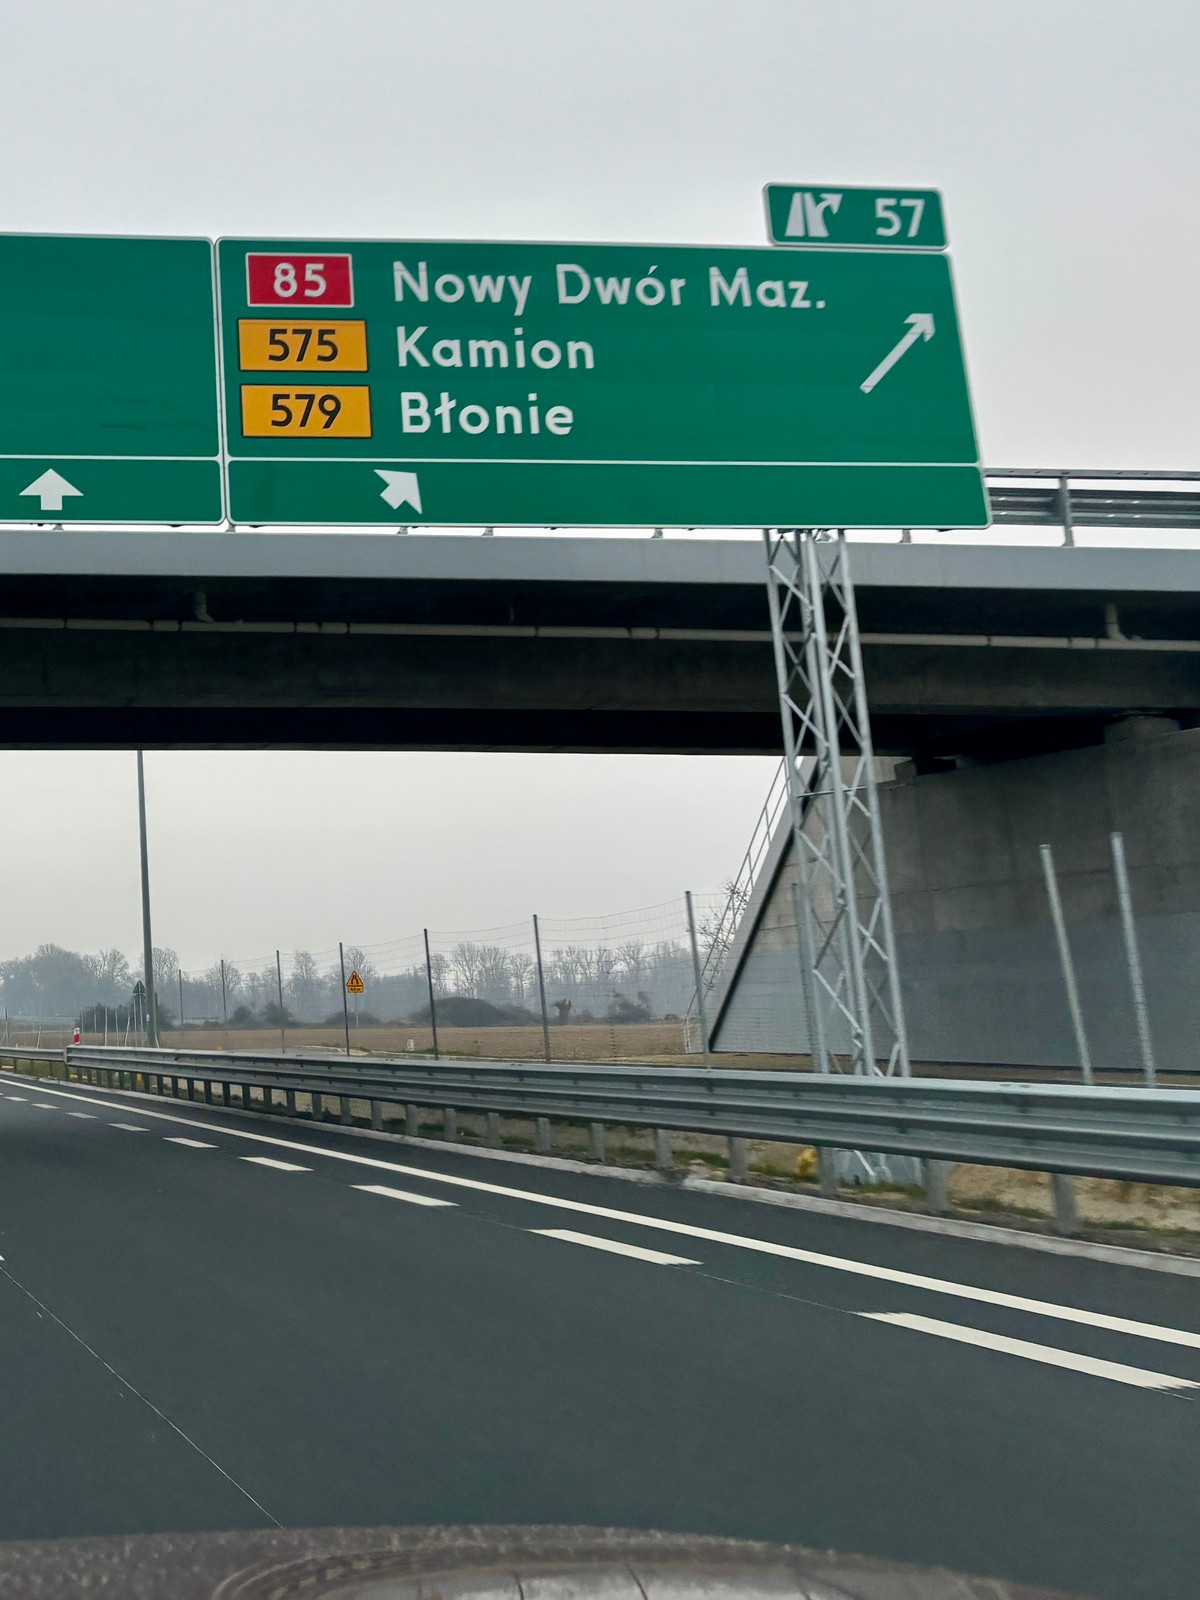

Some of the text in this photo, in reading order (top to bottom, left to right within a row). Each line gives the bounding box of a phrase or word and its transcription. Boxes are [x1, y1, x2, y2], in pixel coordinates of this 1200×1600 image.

[874, 197, 925, 238] 57
[273, 261, 327, 298] 85
[393, 261, 826, 316] Nowy Dwór Maz.
[268, 328, 339, 363] 575
[397, 326, 595, 370] Kamion
[271, 393, 342, 429] 579
[400, 391, 574, 436] Błonie
